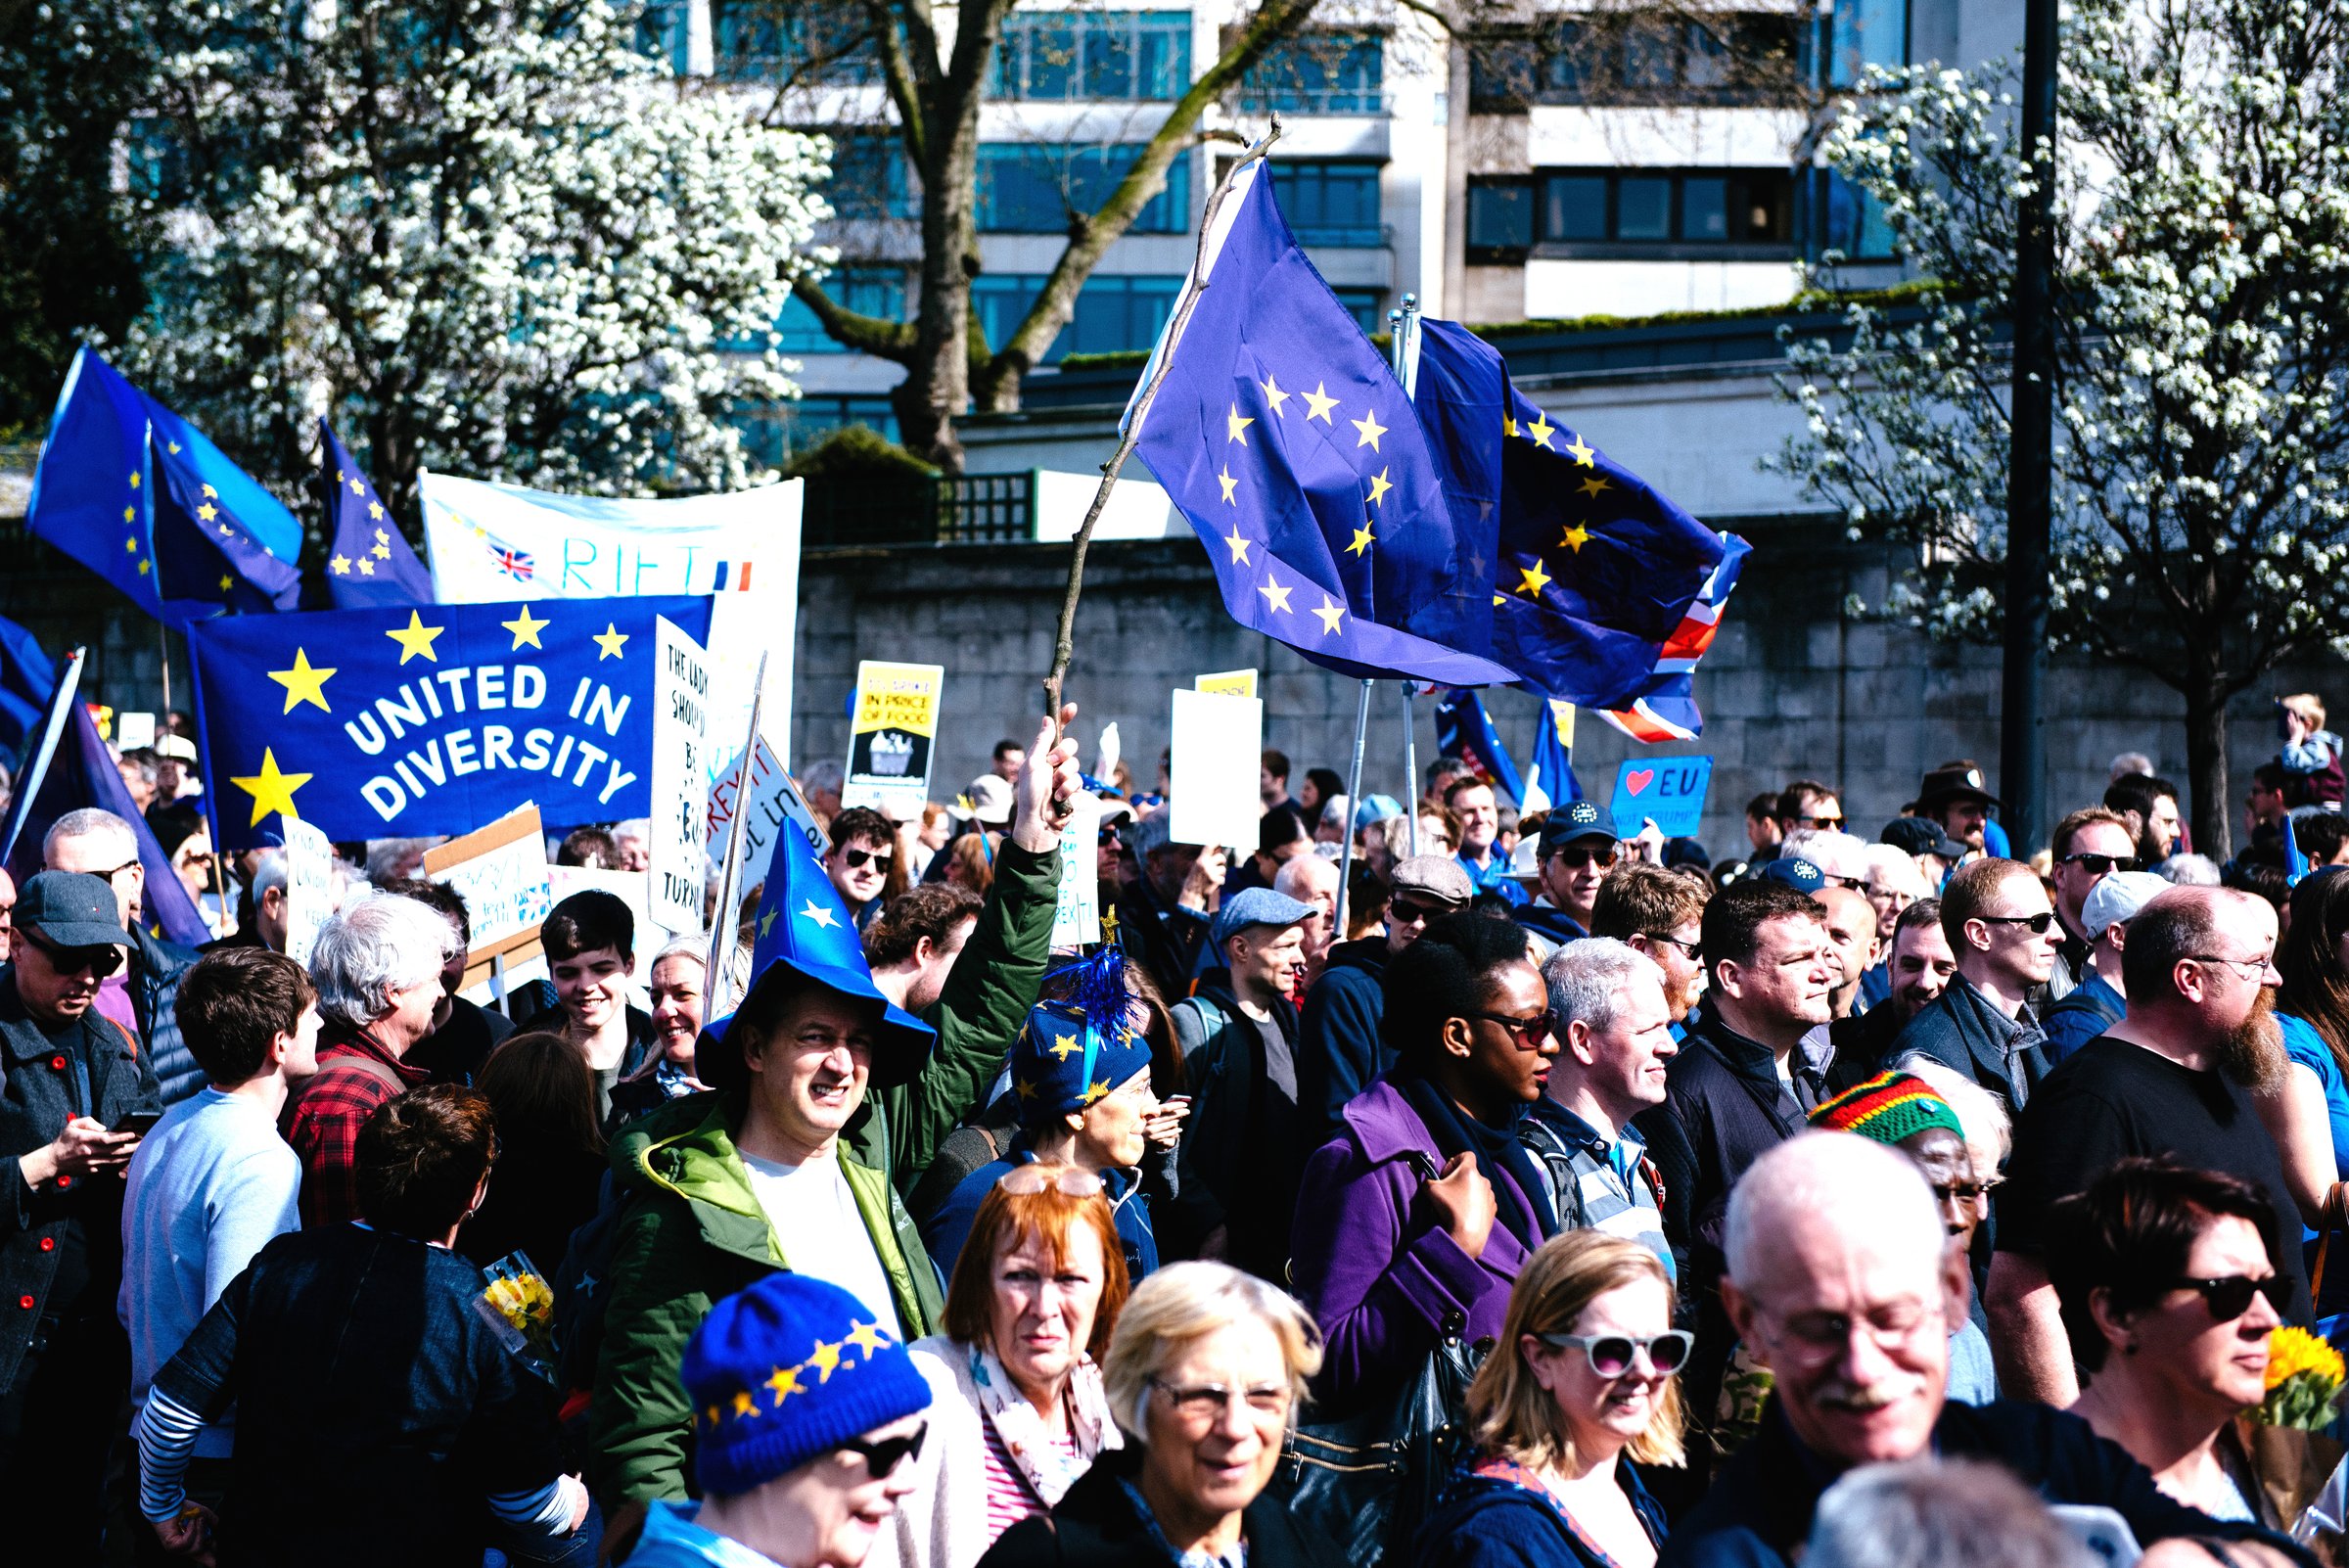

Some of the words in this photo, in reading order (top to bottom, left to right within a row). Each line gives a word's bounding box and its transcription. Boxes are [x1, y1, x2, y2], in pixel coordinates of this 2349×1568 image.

[668, 643, 687, 681] THE
[689, 659, 709, 700] LADY
[344, 664, 547, 756] UNITED
[568, 675, 632, 737] IN
[360, 724, 638, 823] DIVERSITY
[1659, 767, 1699, 796] EU
[1616, 813, 1638, 827] NOT
[1648, 809, 1694, 826] TRUMP
